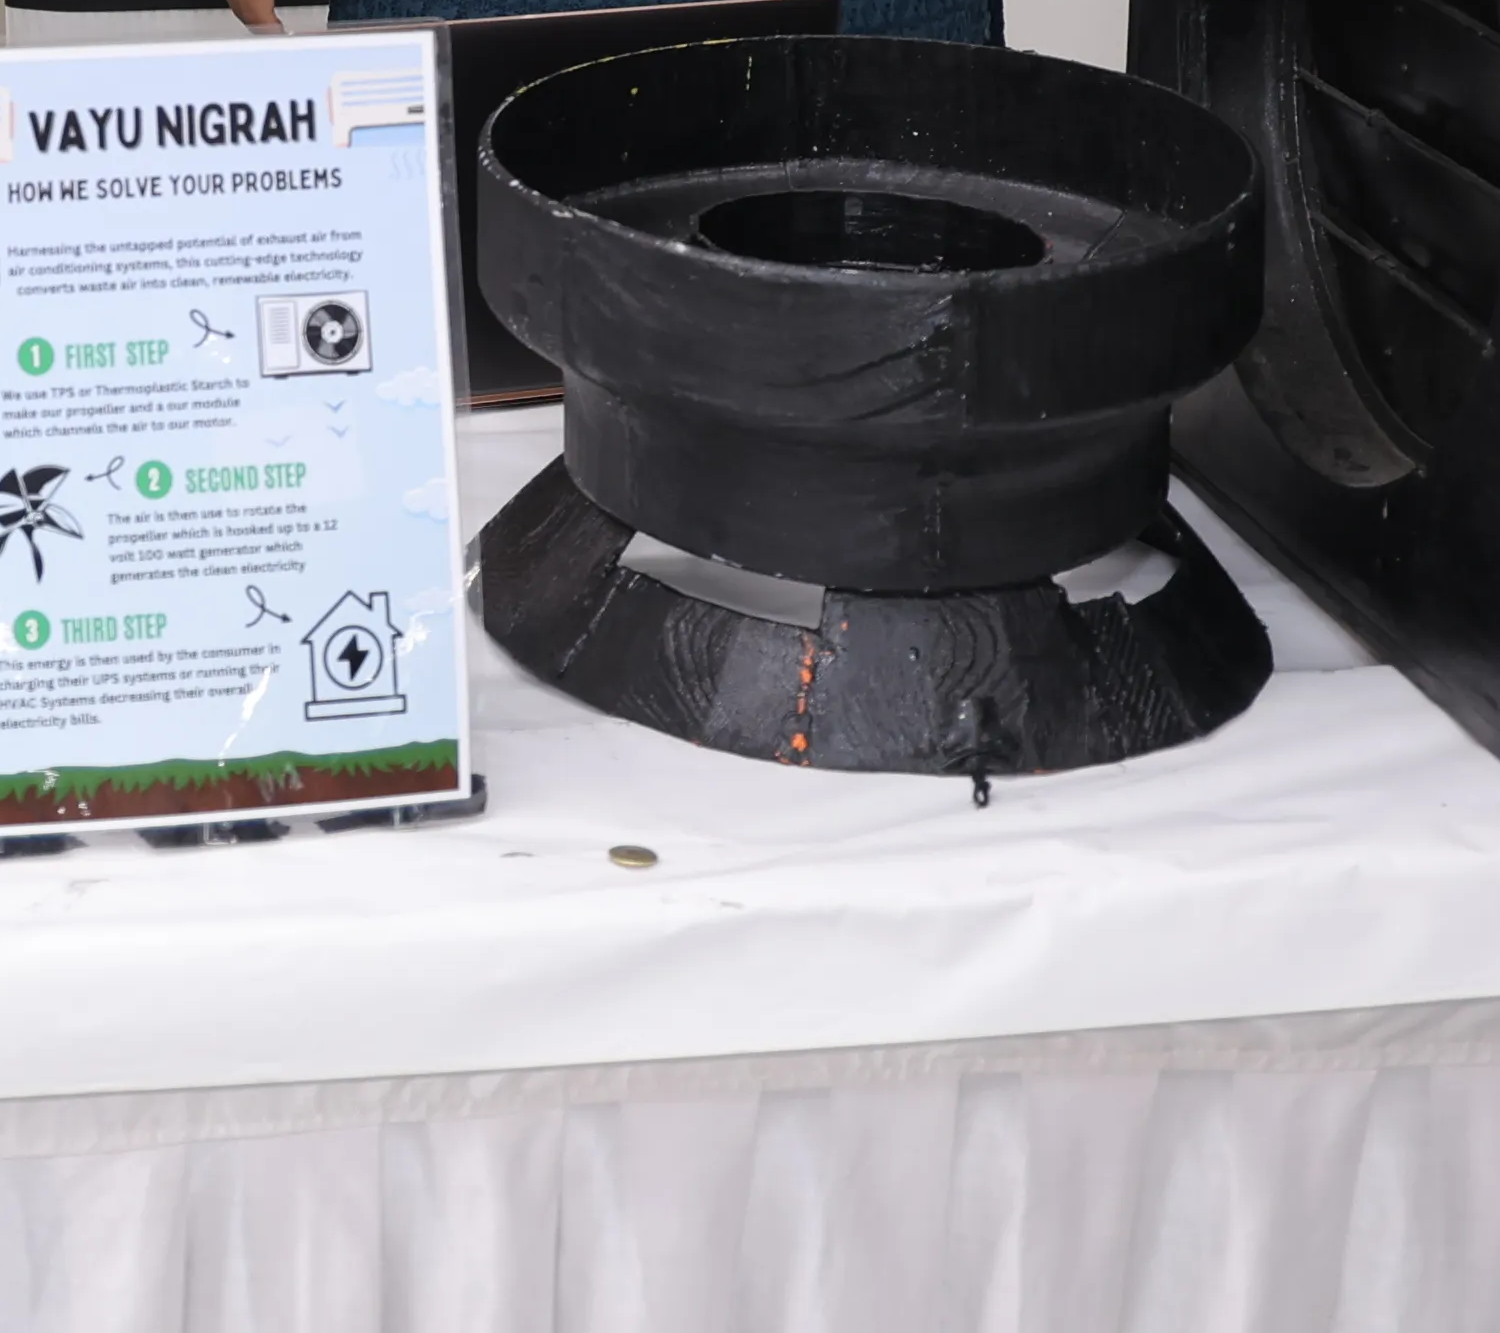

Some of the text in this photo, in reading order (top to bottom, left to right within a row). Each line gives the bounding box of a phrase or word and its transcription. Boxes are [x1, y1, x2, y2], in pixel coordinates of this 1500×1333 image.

[28, 101, 316, 151] VAYU NIGRAH
[7, 168, 342, 202] HOW WE SOLVE YOUR PROBLEMS
[238, 233, 254, 246] of
[29, 344, 42, 369] 1
[147, 462, 306, 493] 2 SECOND STEP
[25, 612, 167, 643] 3 THIRD STEP
